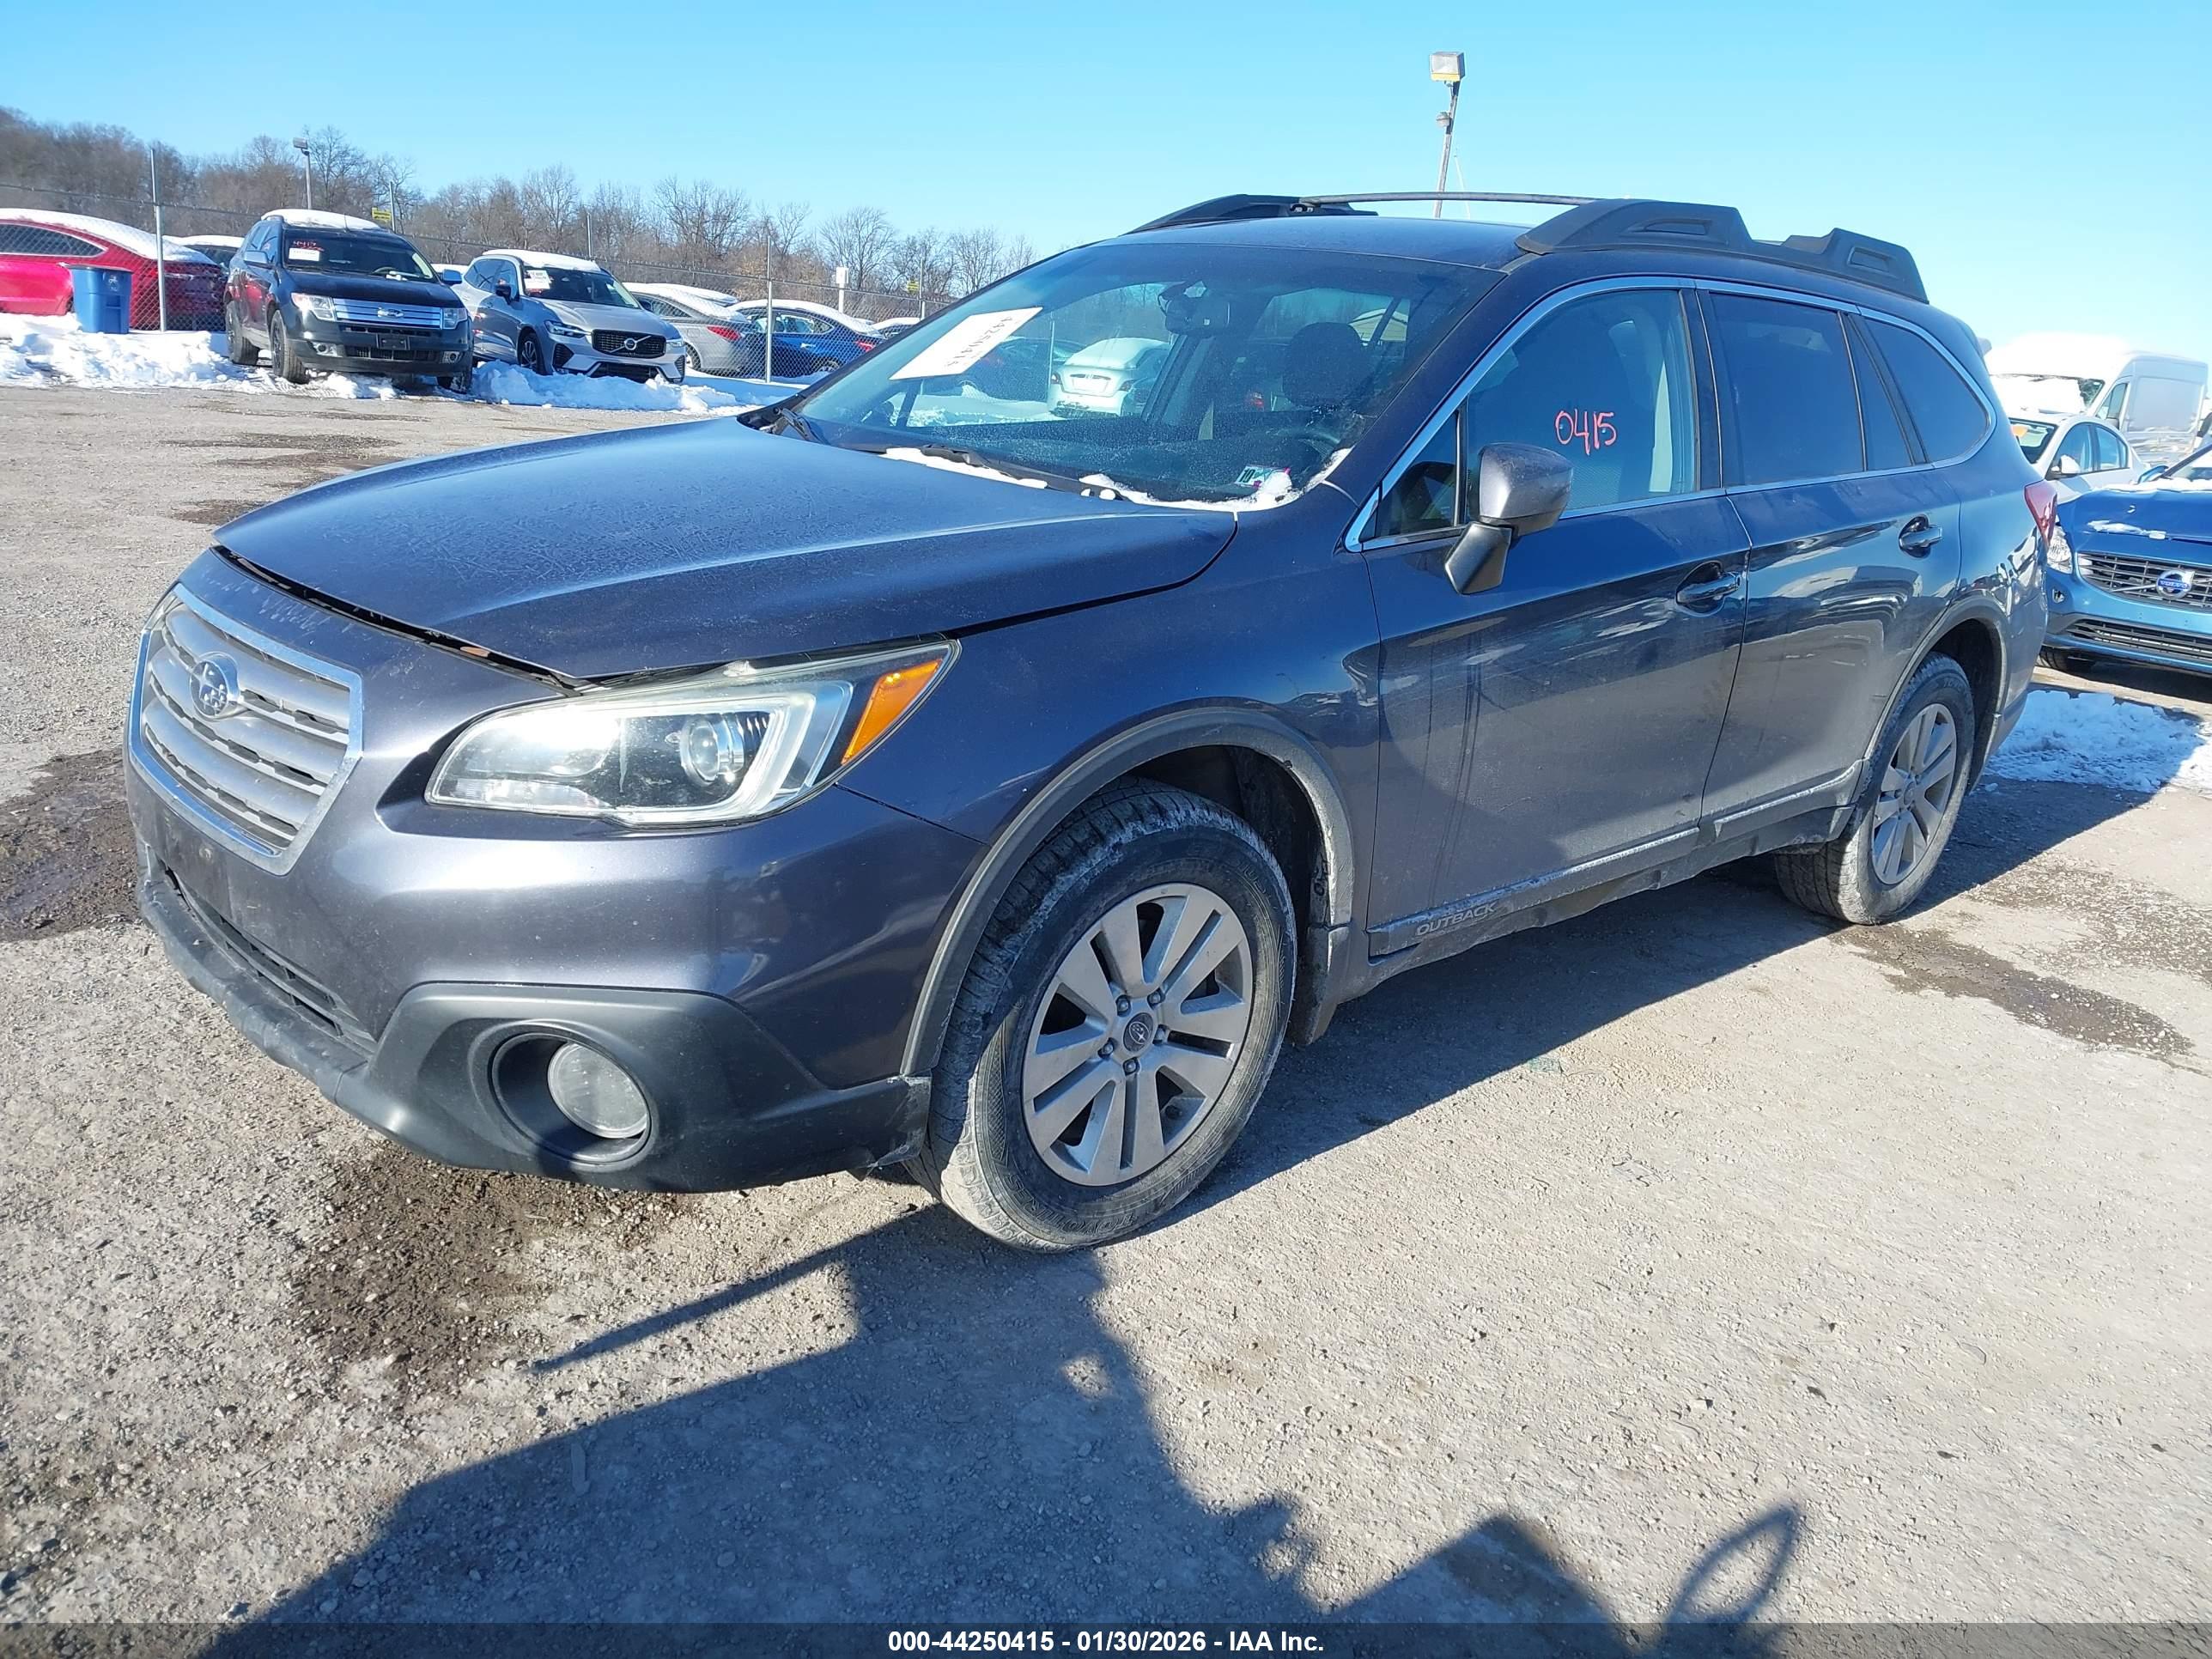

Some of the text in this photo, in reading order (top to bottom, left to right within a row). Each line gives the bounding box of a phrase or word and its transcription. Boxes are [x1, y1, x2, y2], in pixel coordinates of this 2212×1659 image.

[1554, 408, 1617, 456] 0415
[1238, 468, 1256, 483] 10
[2159, 580, 2191, 591] VOLVO
[1415, 901, 1498, 936] OUTBACK
